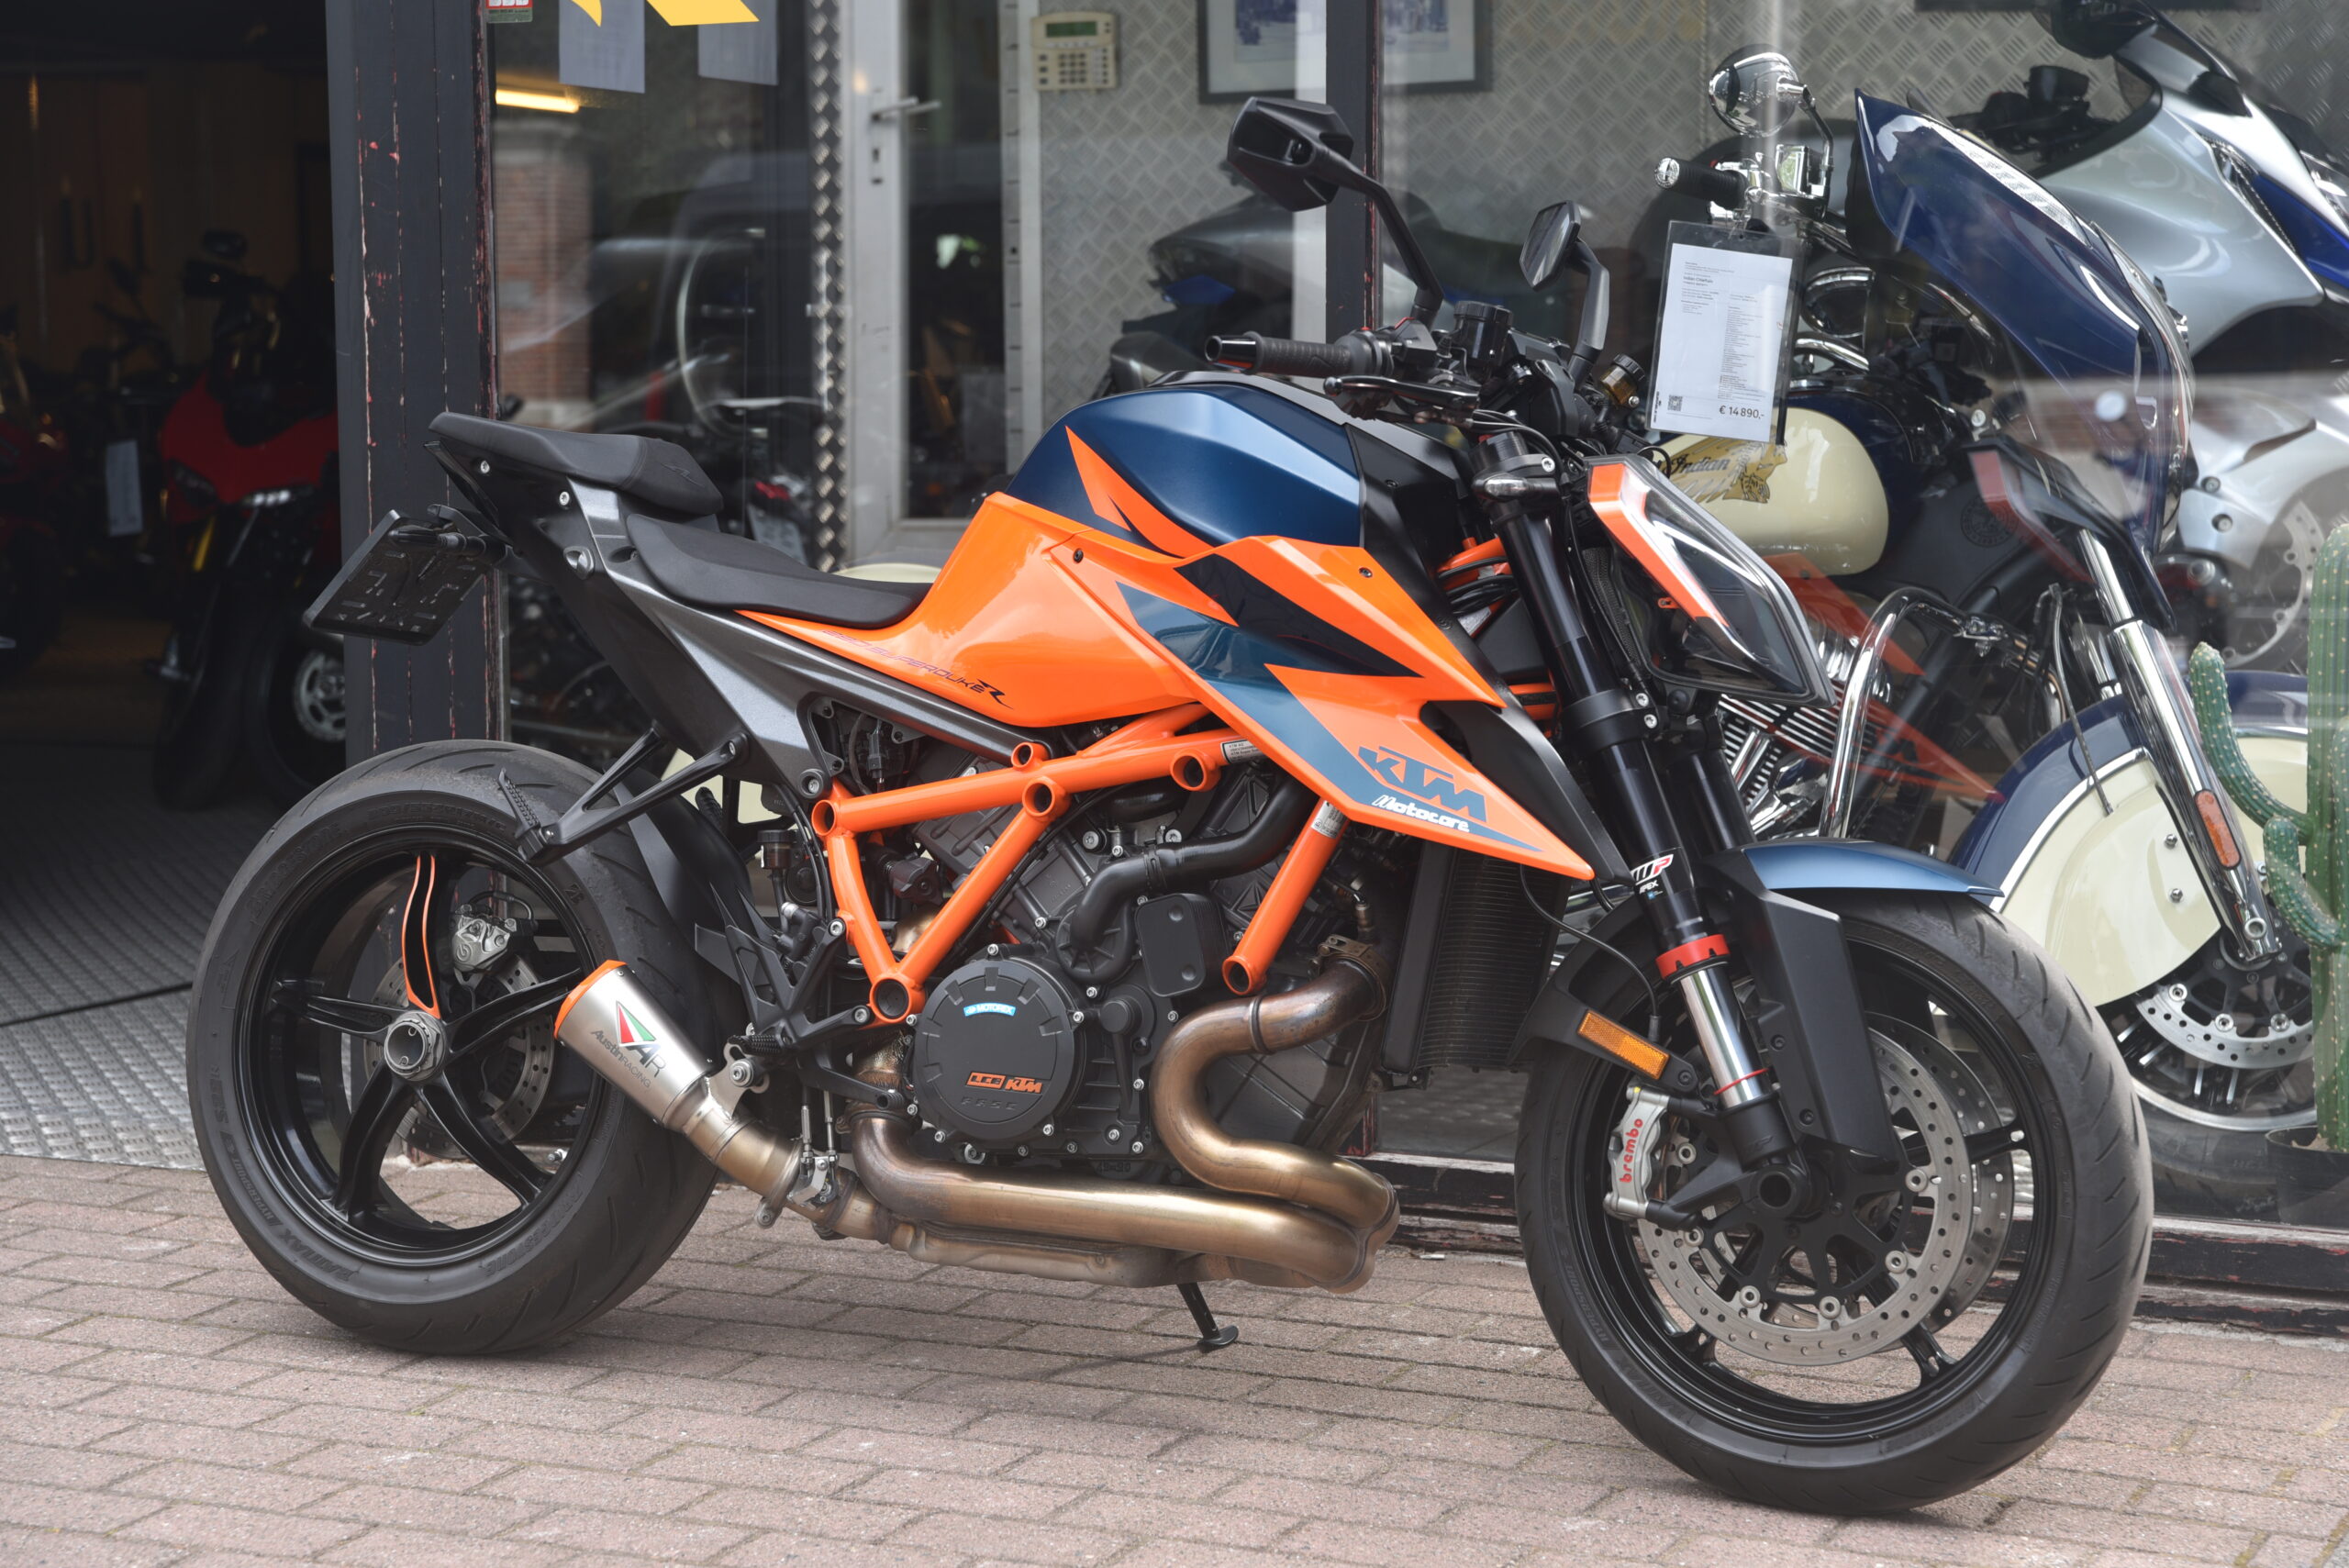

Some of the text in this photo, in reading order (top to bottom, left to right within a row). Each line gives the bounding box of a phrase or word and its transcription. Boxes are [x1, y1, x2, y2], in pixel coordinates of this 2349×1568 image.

[1720, 406, 1726, 415] €
[1358, 746, 1486, 822] KTM
[1372, 795, 1470, 833] Motocare
[977, 1003, 1012, 1015] MOTOREX
[1005, 1076, 1042, 1094] KTM
[1619, 1118, 1643, 1184] brembo
